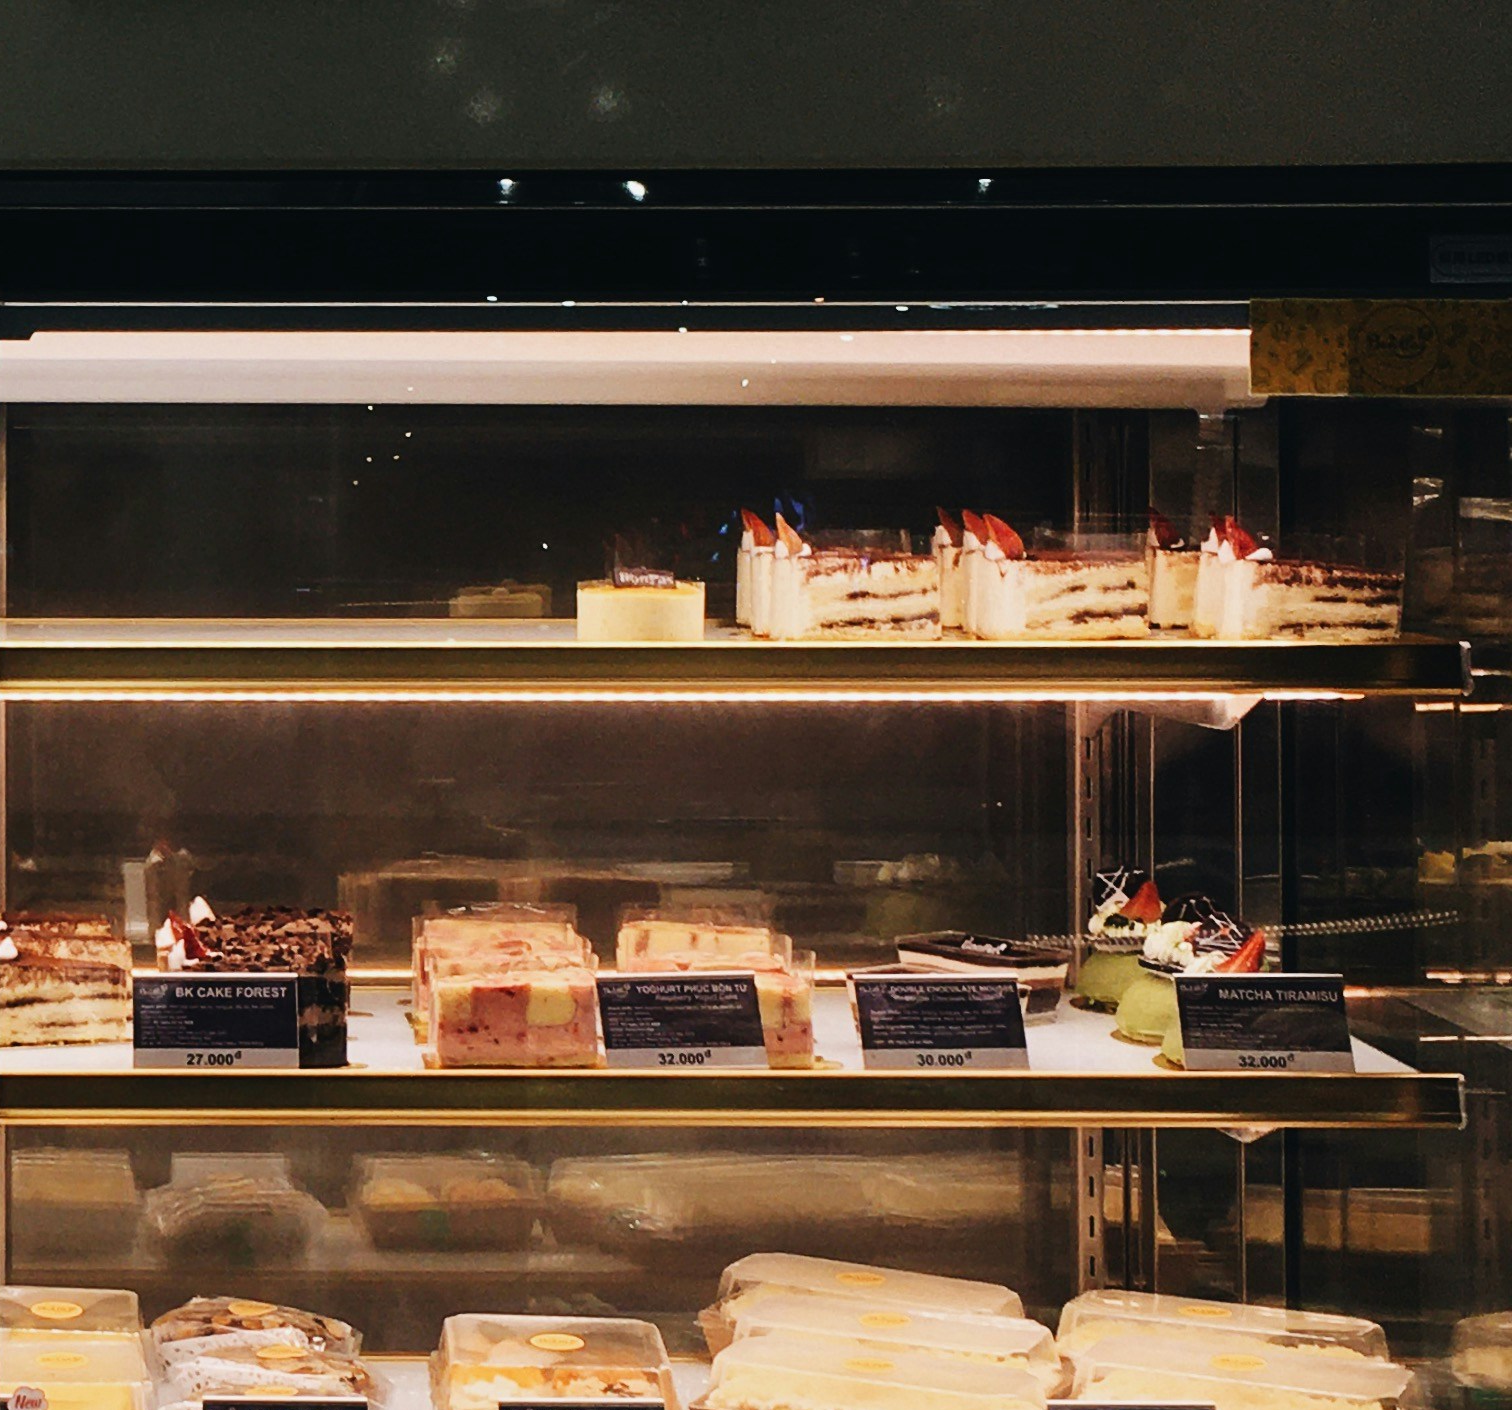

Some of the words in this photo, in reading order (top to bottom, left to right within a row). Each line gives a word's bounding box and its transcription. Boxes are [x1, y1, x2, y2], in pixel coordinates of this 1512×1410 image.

[175, 987, 194, 998] BK
[197, 987, 232, 998] CAKE
[236, 987, 287, 998] FOREST
[636, 984, 681, 994] YOGHURT
[1218, 989, 1273, 1001] MATCHA
[1276, 990, 1338, 1002] TIRAMISU
[14, 1394, 42, 1410] New
